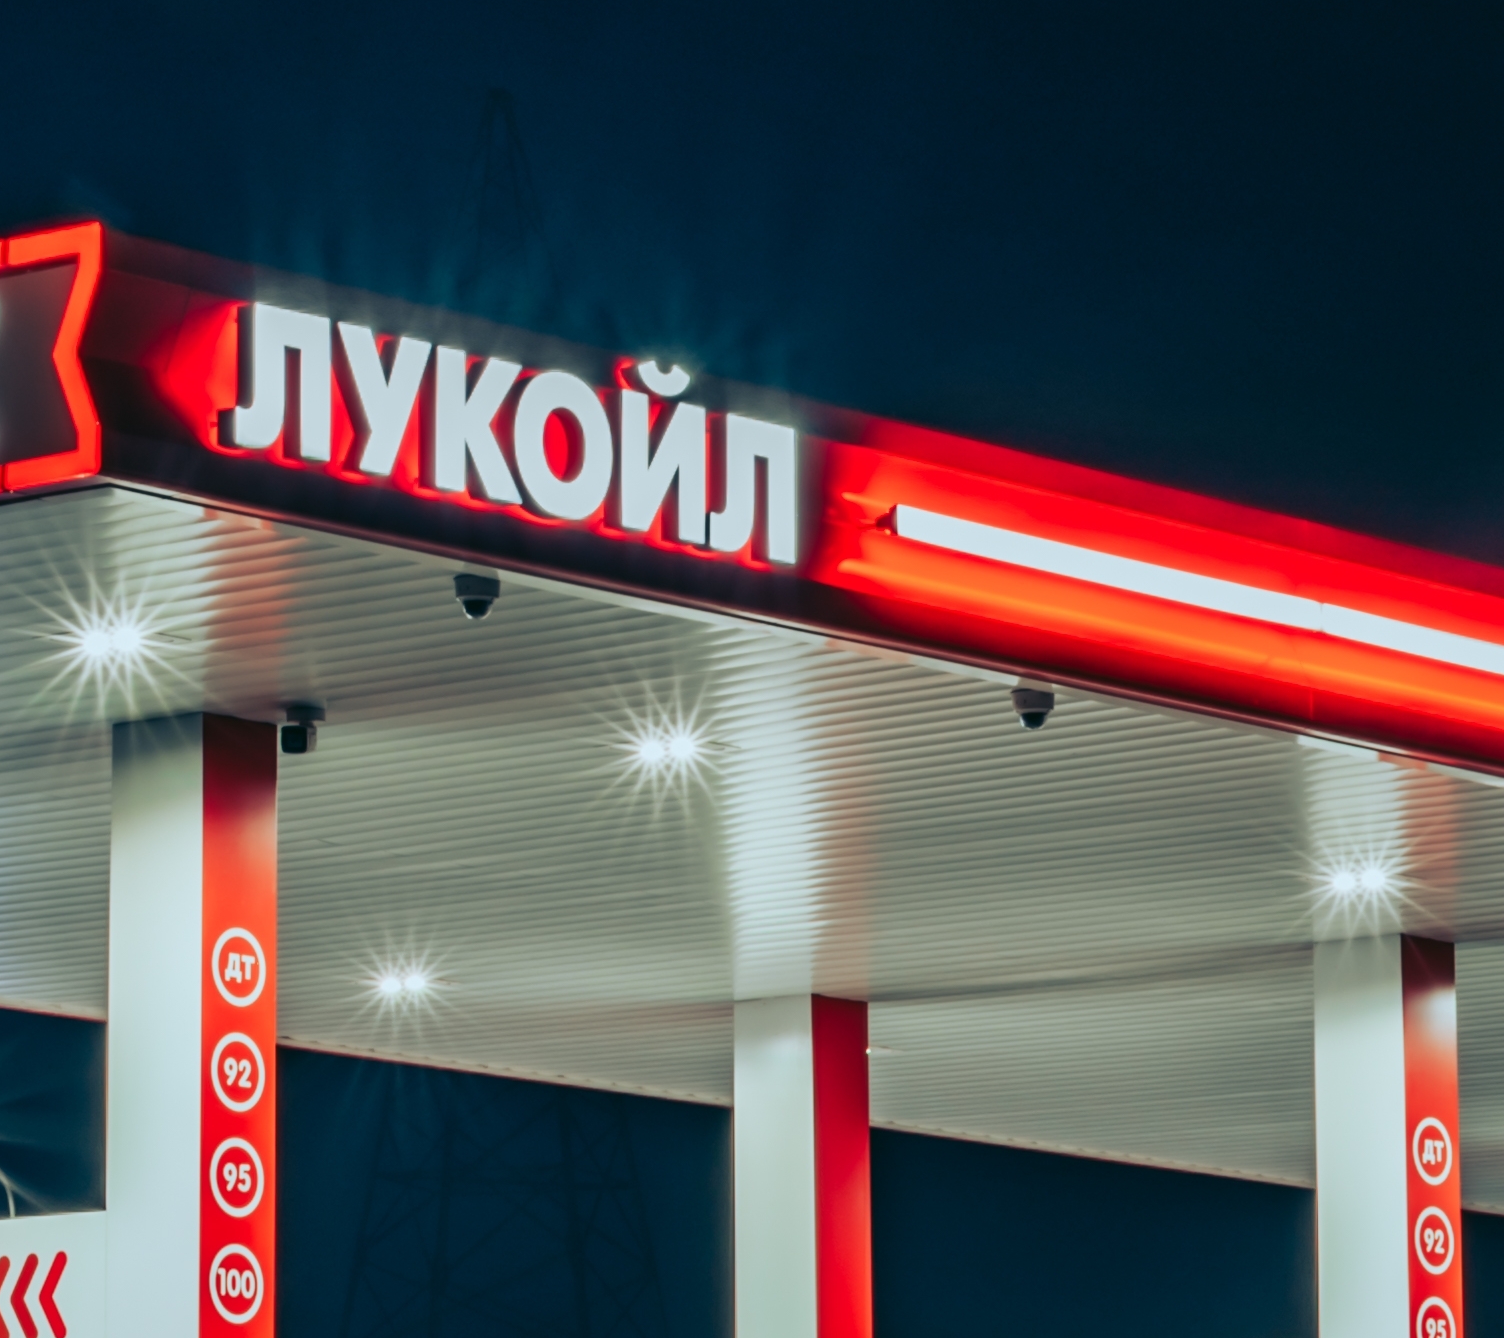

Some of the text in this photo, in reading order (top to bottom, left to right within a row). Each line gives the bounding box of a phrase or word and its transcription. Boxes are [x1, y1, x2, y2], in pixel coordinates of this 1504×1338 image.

[226, 302, 796, 563] ЛУКОЙЛ
[224, 952, 255, 983] ДТ
[223, 1057, 252, 1089] 92
[1422, 1138, 1445, 1165] ДТ
[222, 1163, 251, 1193] 95
[1423, 1227, 1445, 1255] 92
[217, 1267, 256, 1299] 100
